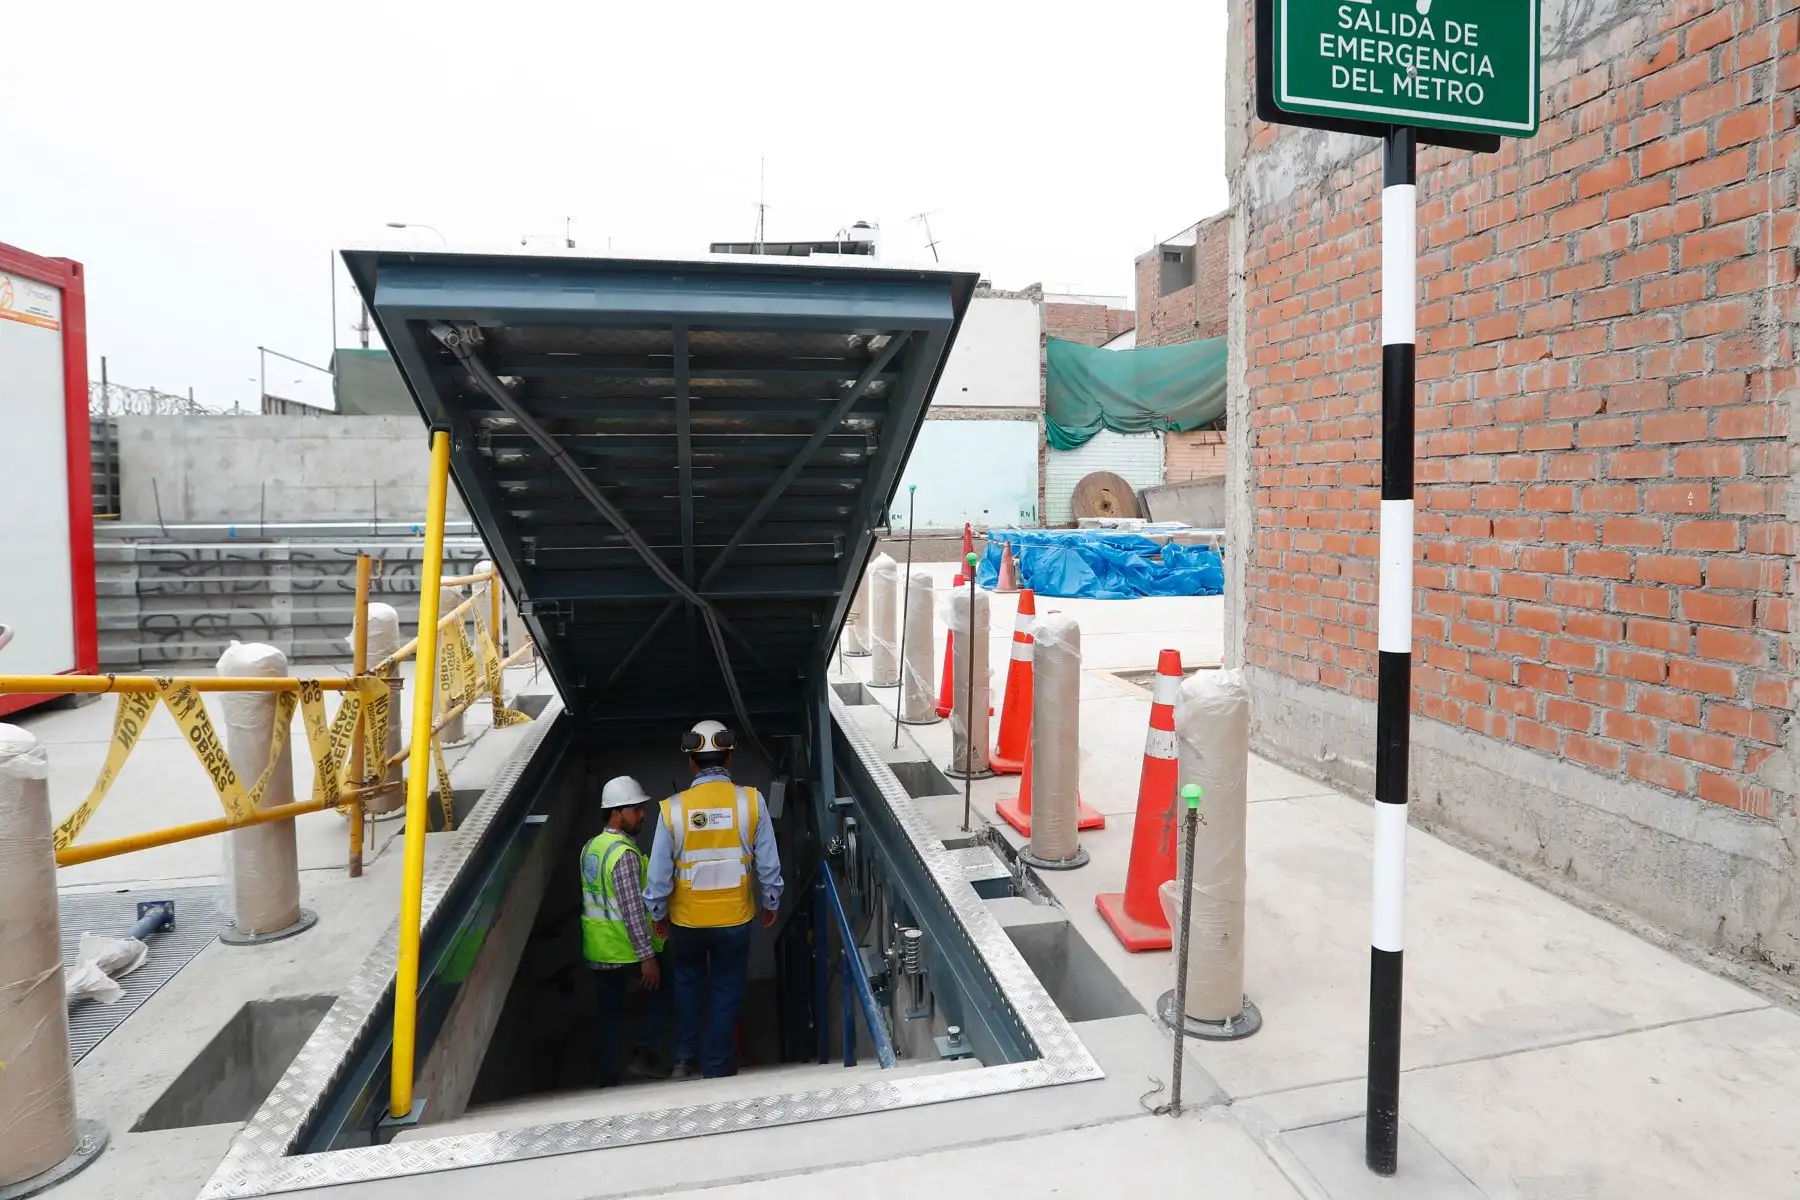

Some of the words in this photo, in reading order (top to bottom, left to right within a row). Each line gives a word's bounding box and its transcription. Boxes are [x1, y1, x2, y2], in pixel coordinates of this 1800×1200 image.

[1338, 5, 1436, 41] SALIDA
[1444, 21, 1479, 47] DE
[1319, 32, 1495, 78] EMERGENCIA
[1331, 65, 1384, 94] DEL
[1393, 73, 1485, 106] METRO
[190, 725, 227, 792] OBRAS
[195, 708, 236, 785] PELIGRO
[324, 751, 334, 775] NO
